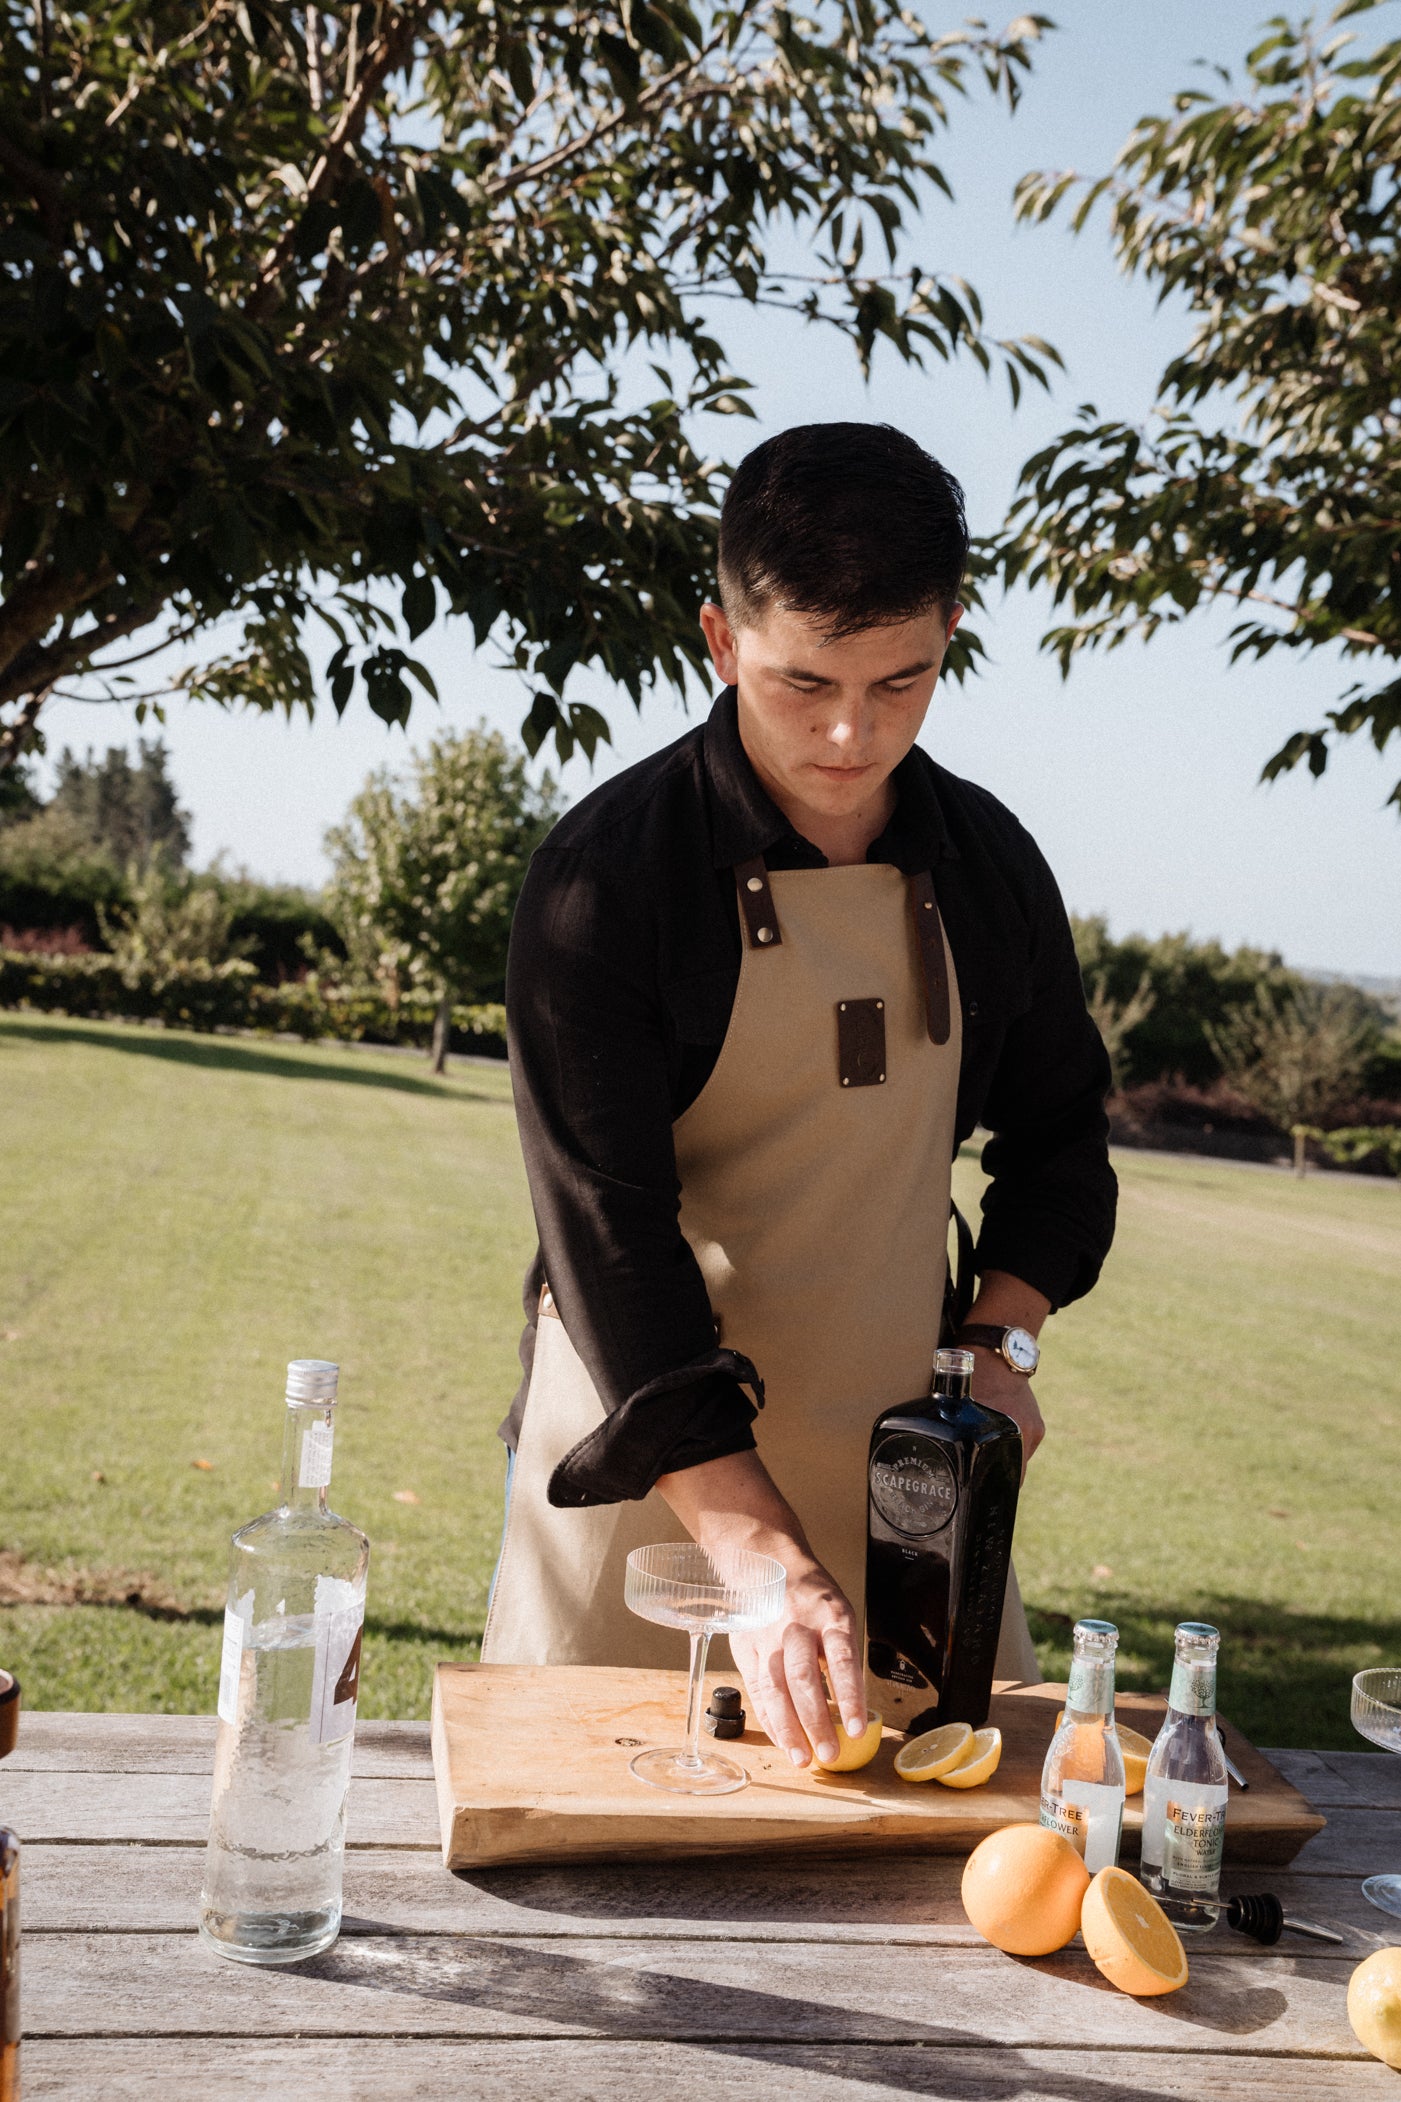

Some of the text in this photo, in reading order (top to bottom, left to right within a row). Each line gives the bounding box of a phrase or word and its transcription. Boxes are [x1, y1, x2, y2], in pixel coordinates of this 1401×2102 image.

[892, 1456, 937, 1479] PREMIUM
[874, 1471, 951, 1501] SCAPEGRACE
[901, 1547, 919, 1557] BLACK
[1193, 1838, 1218, 1848] TONIC
